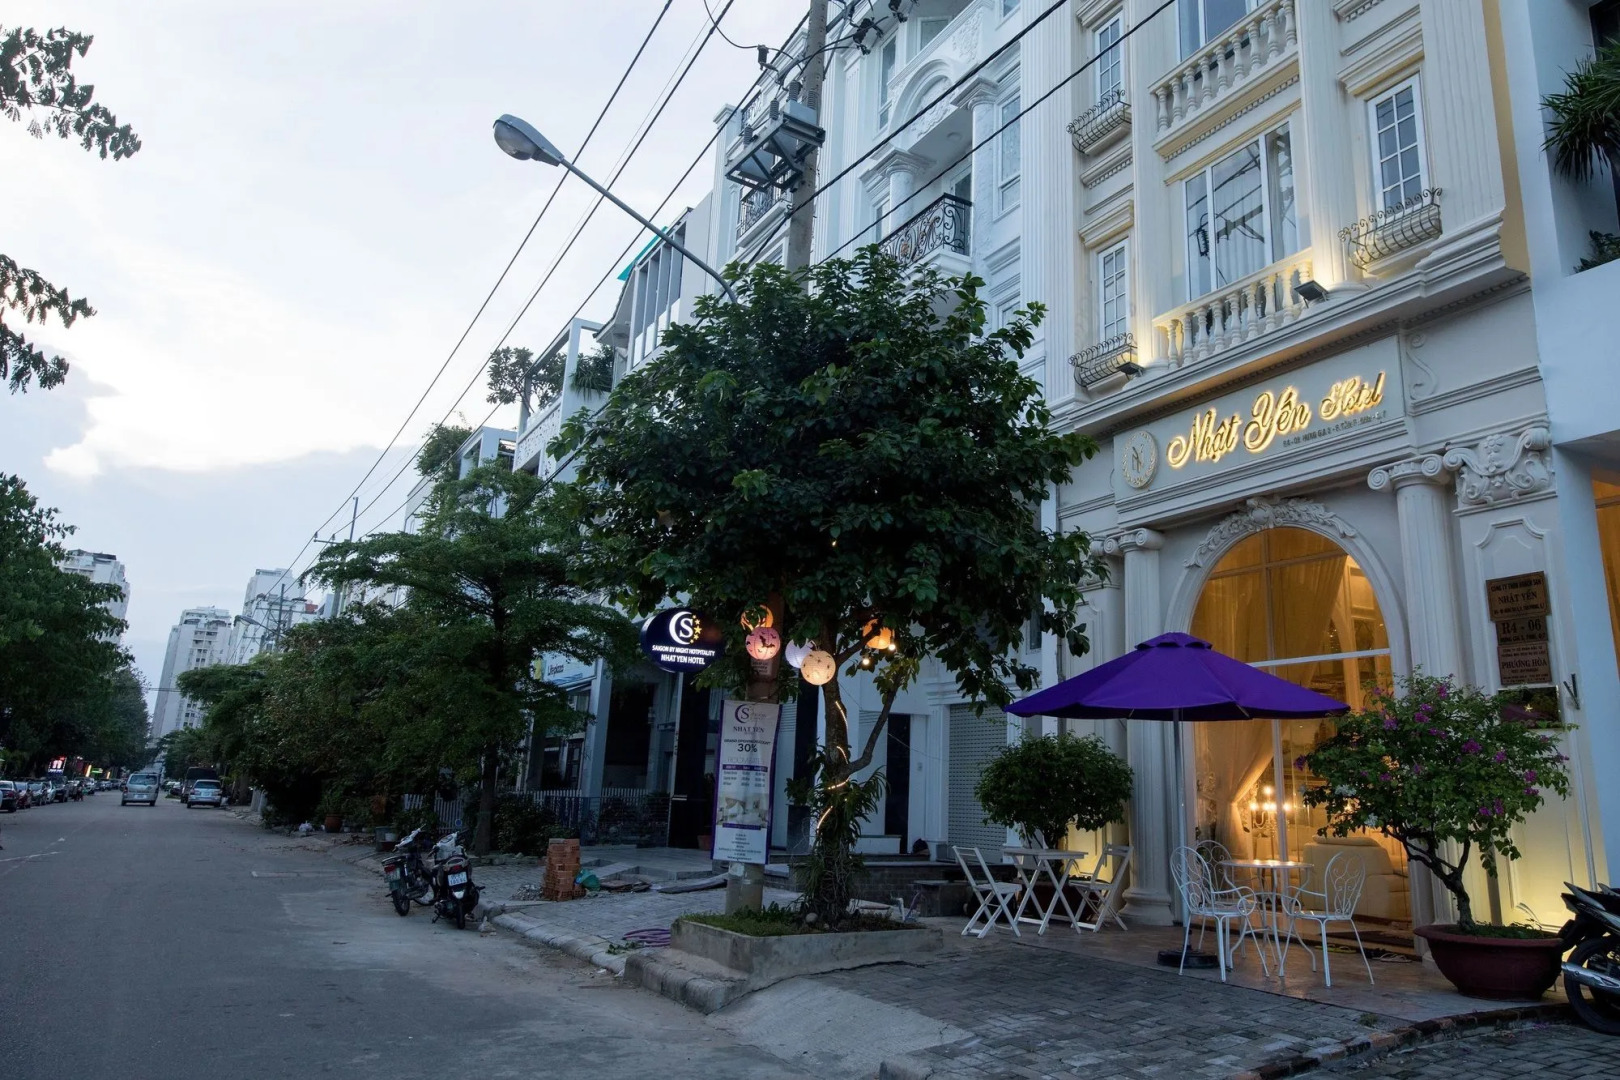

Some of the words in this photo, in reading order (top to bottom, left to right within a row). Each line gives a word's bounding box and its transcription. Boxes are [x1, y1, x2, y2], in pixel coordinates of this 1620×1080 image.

[1502, 621, 1517, 634] R4
[1528, 619, 1542, 631] 06
[652, 644, 669, 652] SAIGON
[675, 646, 689, 654] NIGHT
[661, 654, 676, 662] NHAT
[676, 655, 688, 663] YEN
[688, 657, 705, 665] HOTEL
[737, 743, 758, 753] 30%
